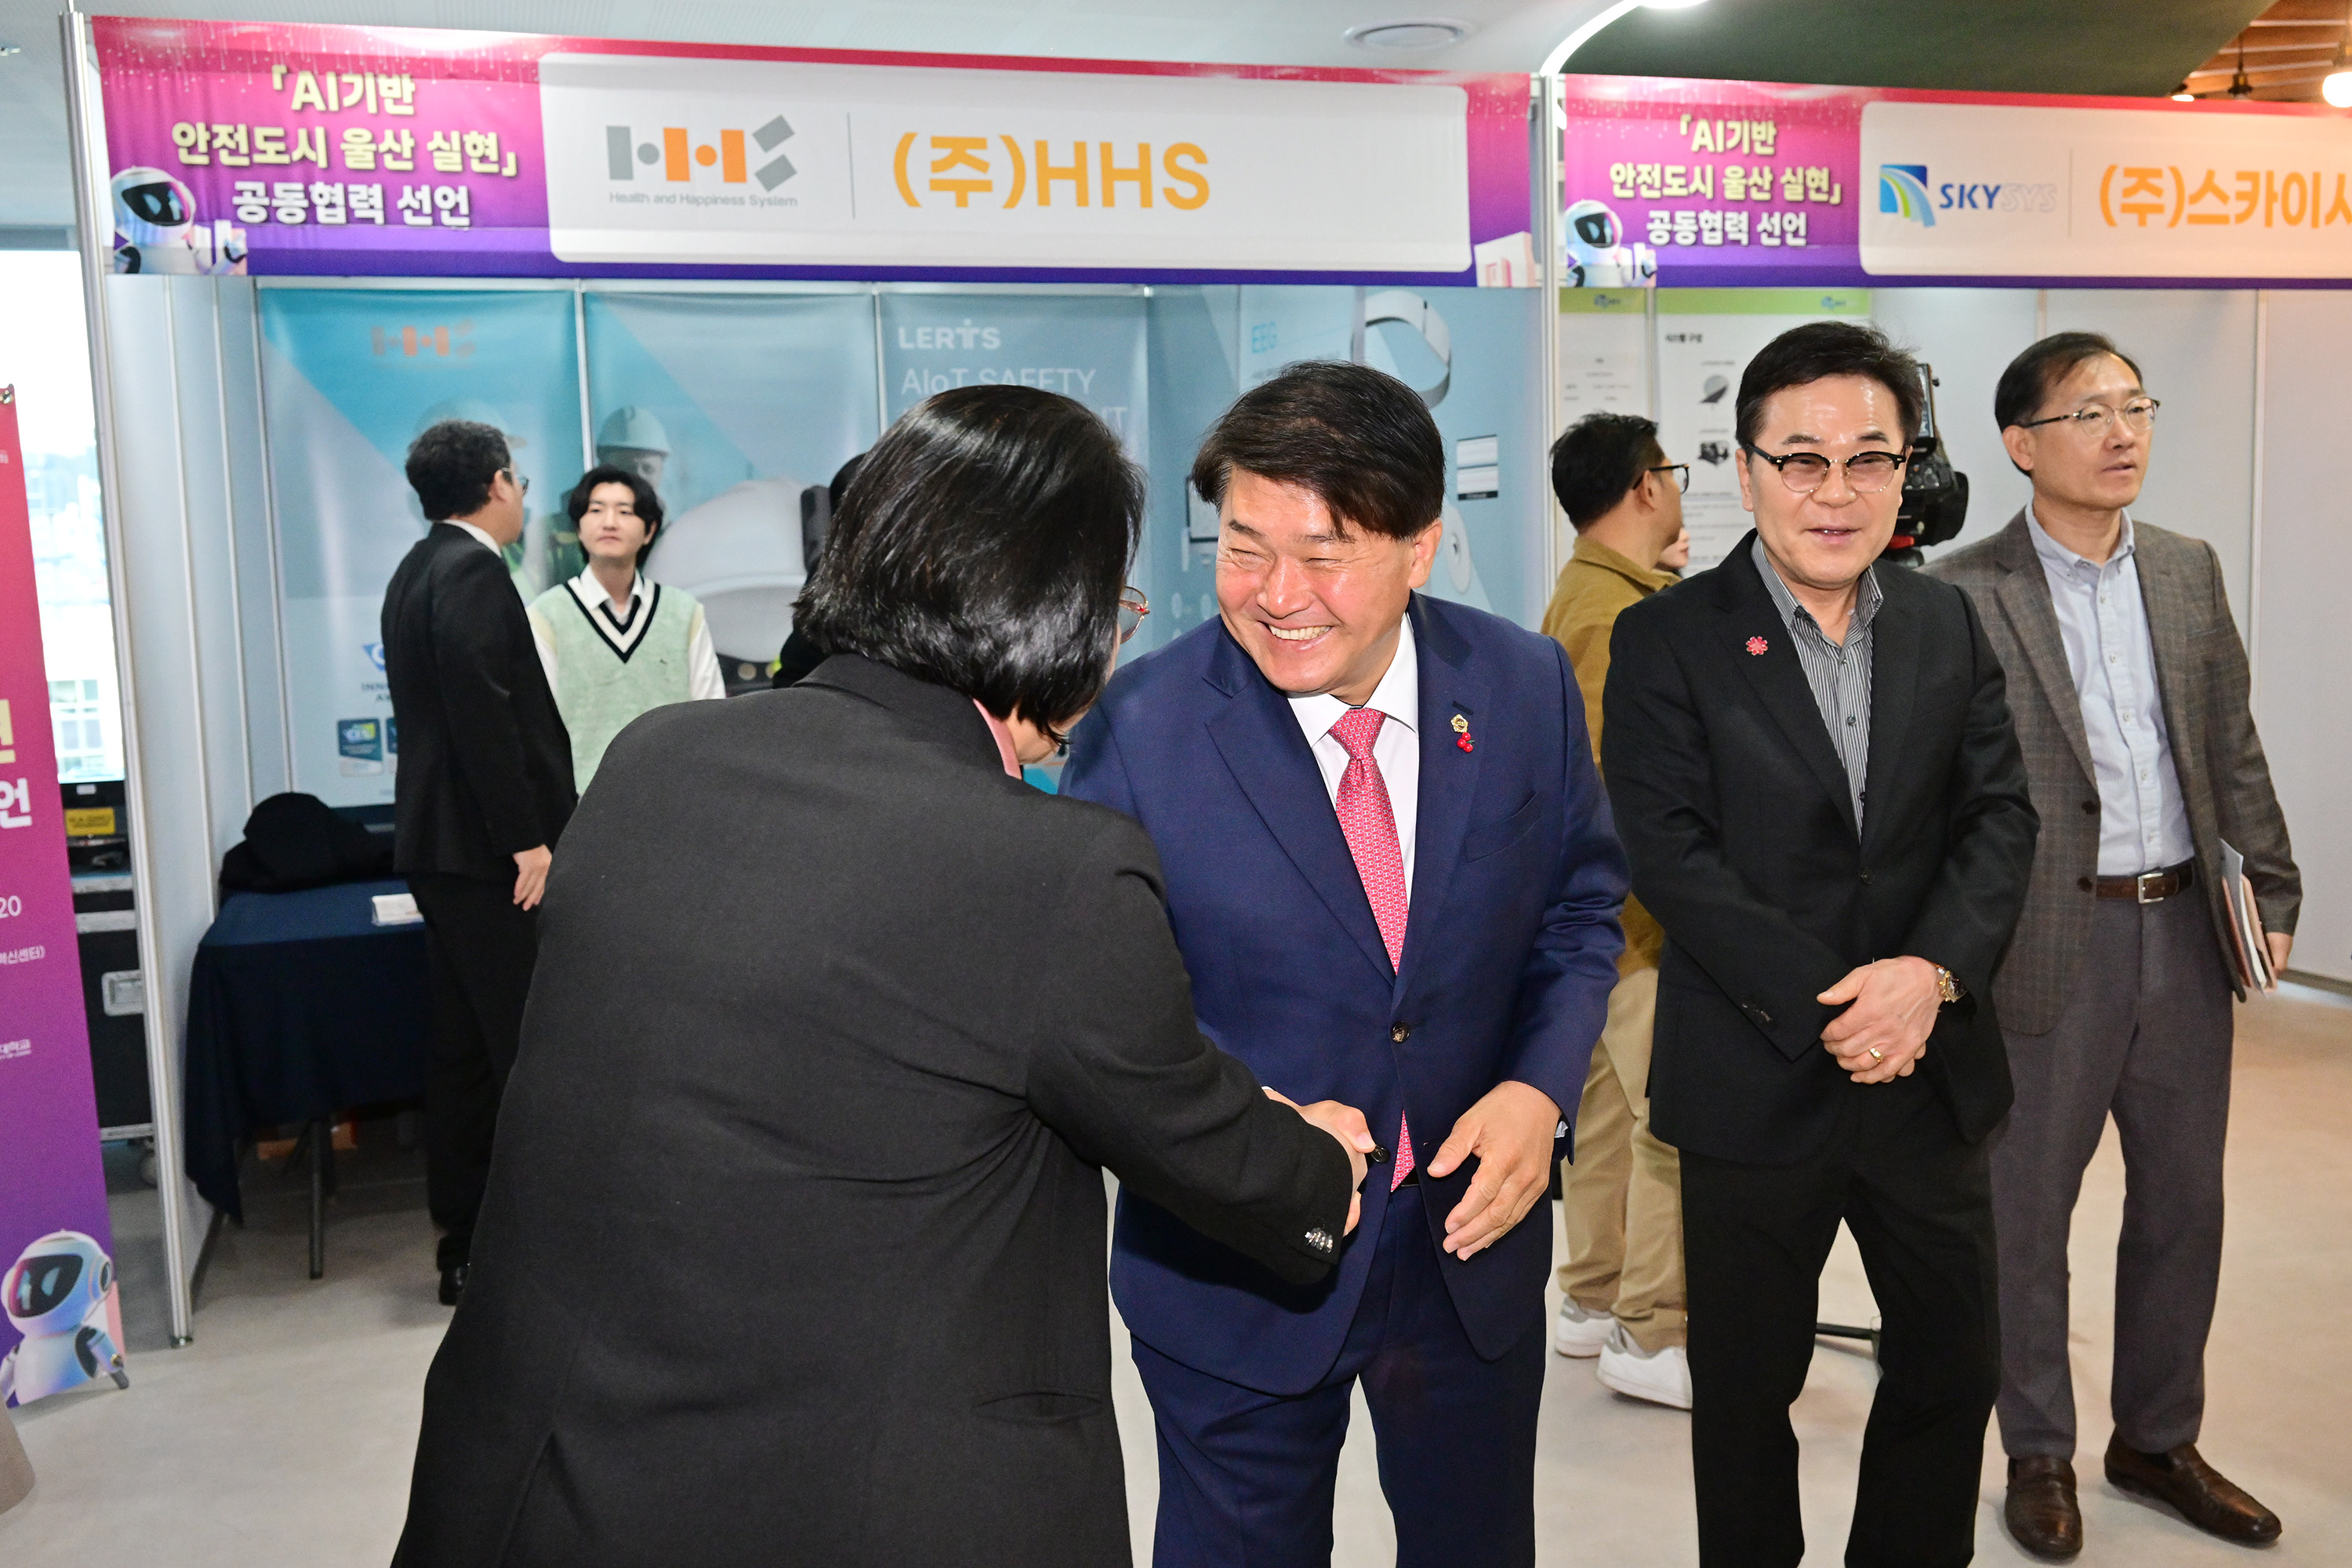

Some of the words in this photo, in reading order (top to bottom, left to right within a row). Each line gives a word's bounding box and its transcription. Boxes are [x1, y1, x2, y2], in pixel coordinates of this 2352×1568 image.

[271, 64, 416, 115] 「AI기반
[172, 122, 328, 169] 안전도시
[339, 127, 415, 171] 울산
[426, 129, 517, 177] 실현」
[1680, 113, 1777, 155] 「AI기반
[893, 132, 1211, 210] (주)HHS
[1610, 162, 1715, 200] 안전도시
[1722, 165, 1774, 201] 울산
[1780, 165, 1842, 205] 실현」
[232, 180, 386, 225] 공동협력
[397, 183, 471, 227] 선언
[608, 191, 651, 205] Health
[653, 192, 677, 205] and
[680, 193, 746, 209] Happiness
[749, 194, 798, 209] System
[1646, 209, 1750, 246] 공동협력
[1756, 211, 1807, 247] 선언
[979, 368, 1096, 394] SAFETY
